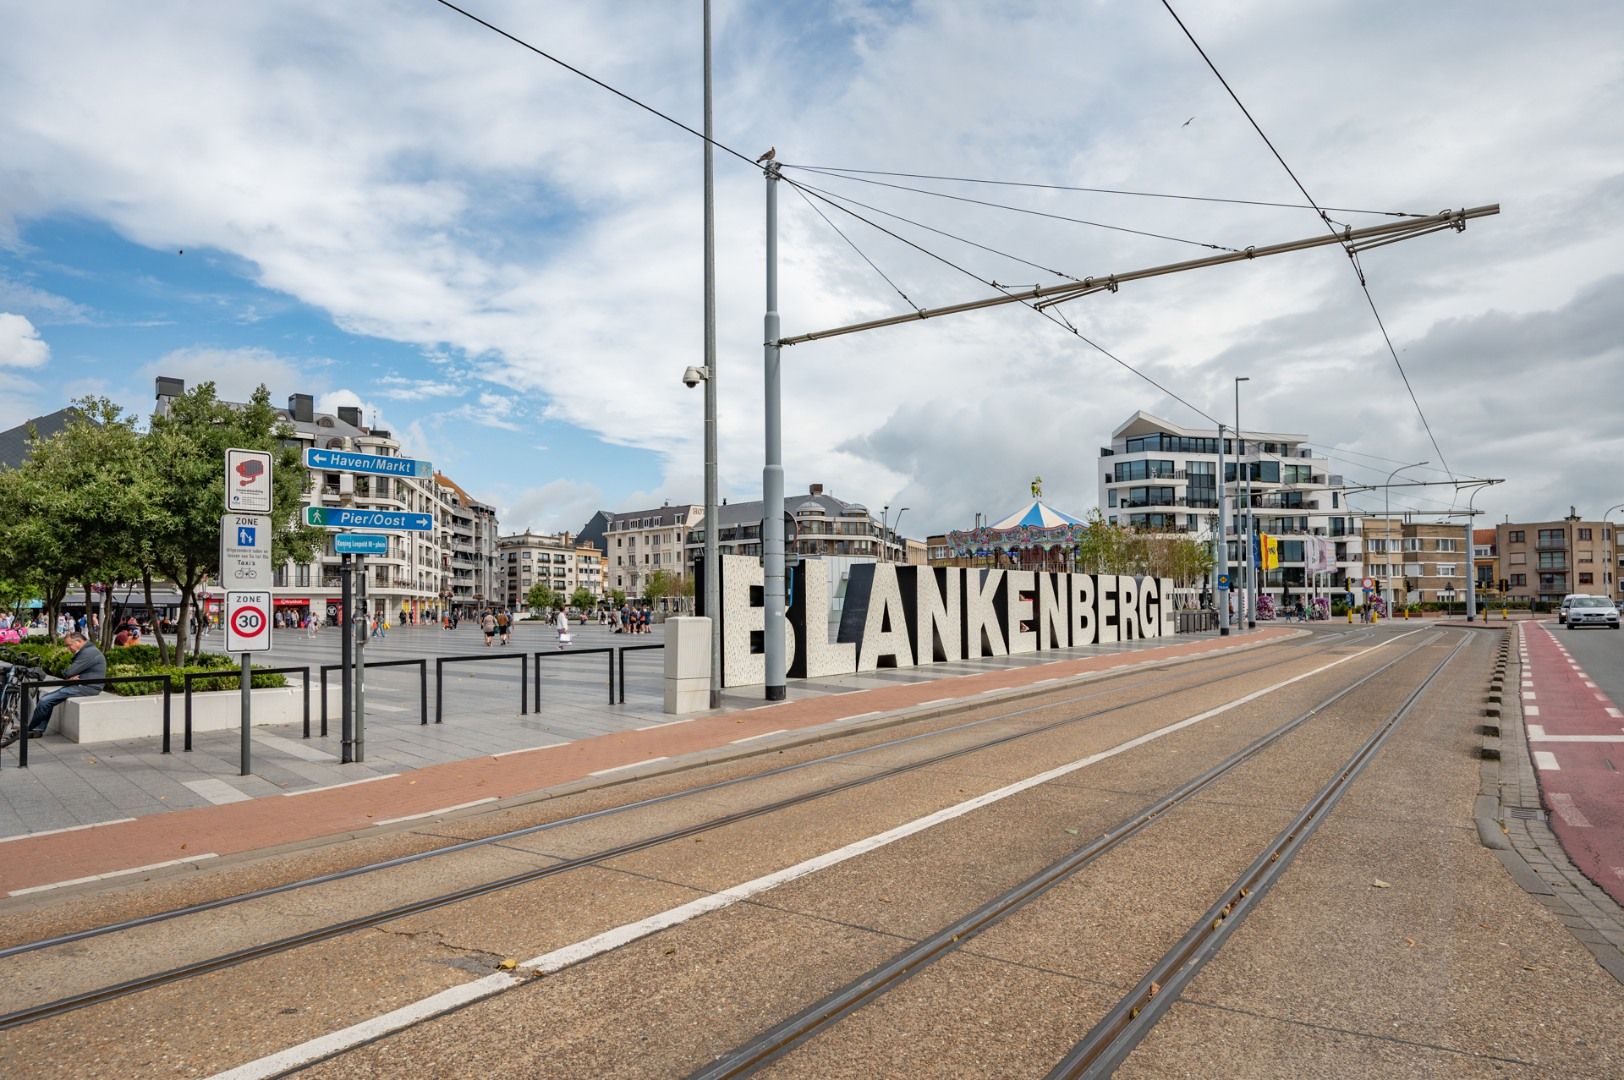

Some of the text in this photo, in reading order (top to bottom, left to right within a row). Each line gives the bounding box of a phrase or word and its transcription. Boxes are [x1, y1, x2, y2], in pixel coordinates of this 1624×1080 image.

[330, 454, 411, 473] Haven/Markt
[235, 517, 258, 526] ZONE
[340, 512, 406, 527] Pier/Oost
[235, 595, 262, 603] ZONE
[238, 615, 259, 628] 30
[720, 554, 1176, 688] BLANKENBERGE
